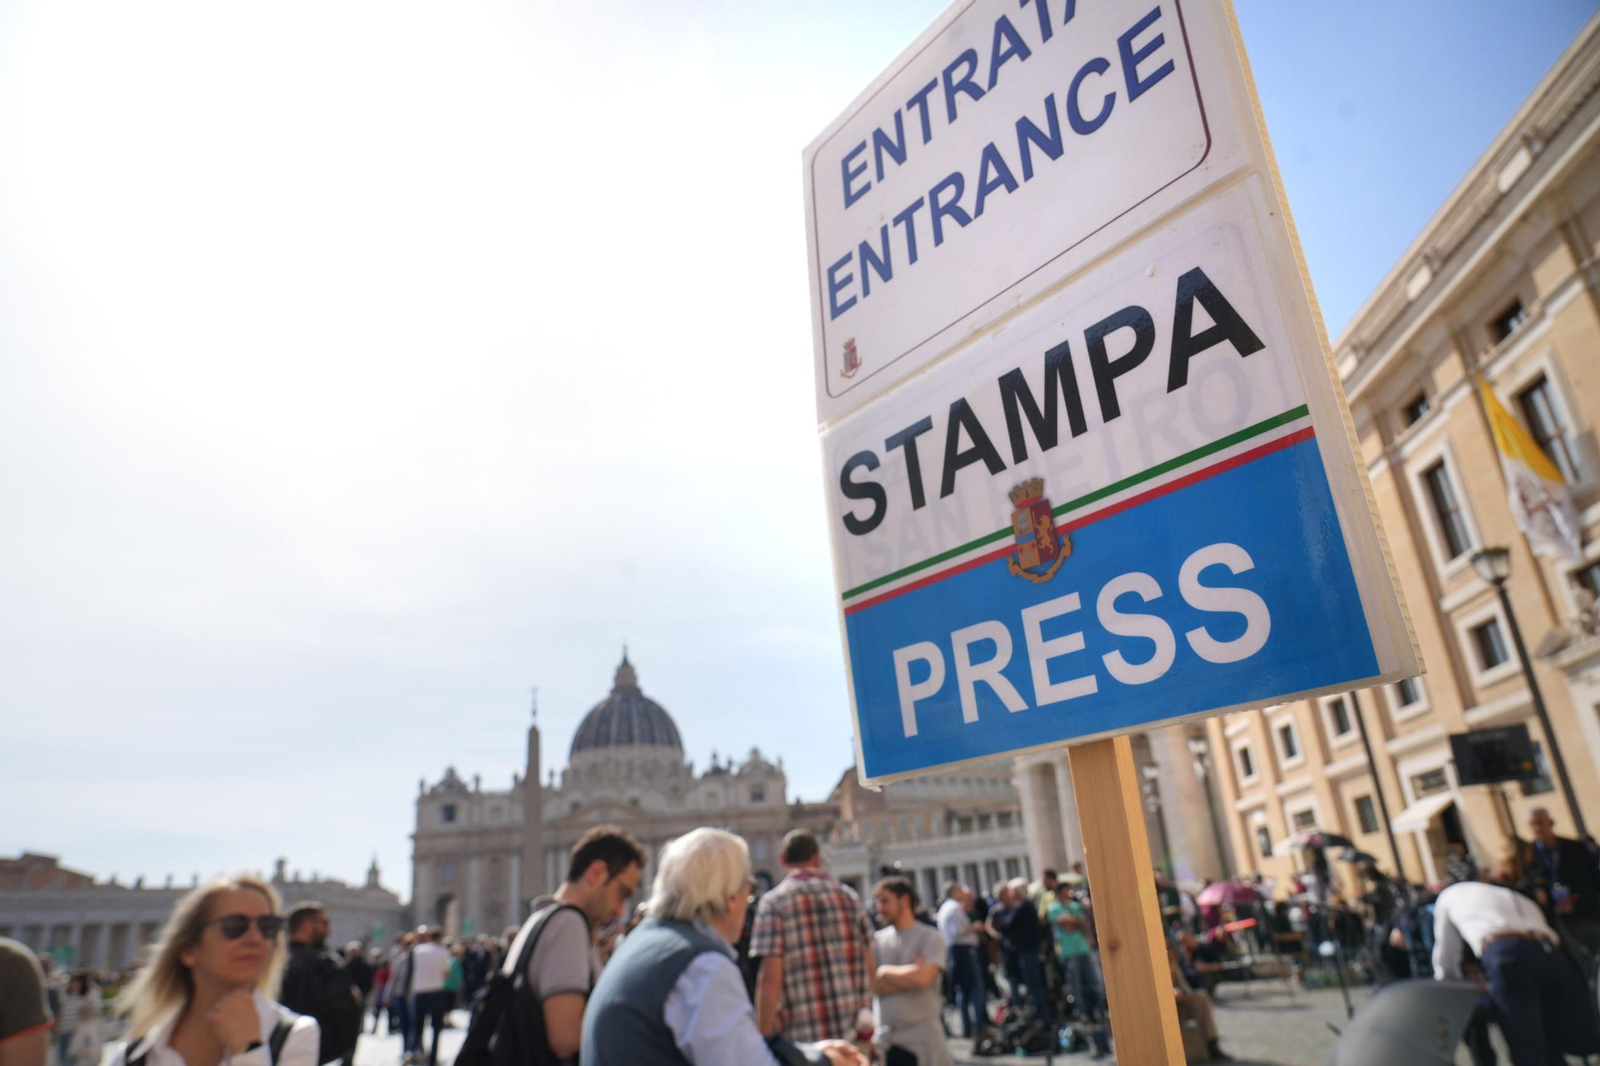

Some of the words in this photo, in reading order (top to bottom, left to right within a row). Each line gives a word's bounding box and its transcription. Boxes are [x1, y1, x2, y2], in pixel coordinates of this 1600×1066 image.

[827, 7, 1175, 320] ENTRANCE
[842, 0, 1075, 208] ENTRAT
[840, 267, 1266, 536] STAMPA
[893, 543, 1271, 737] PRESS
